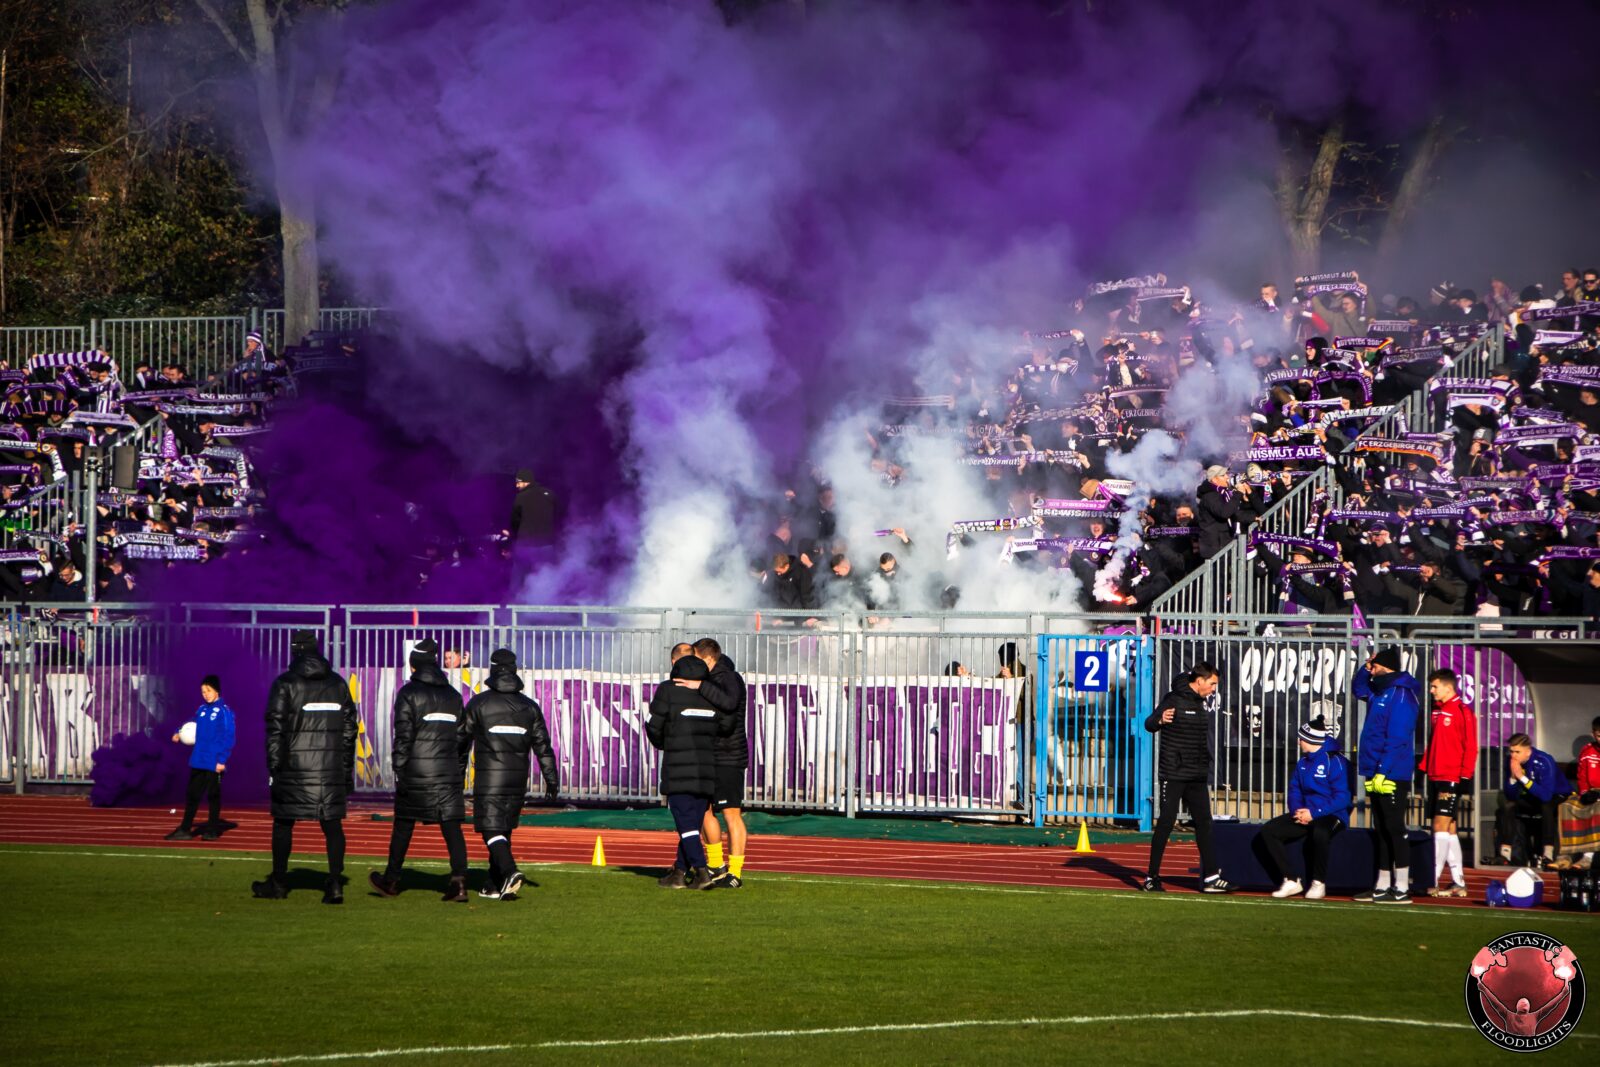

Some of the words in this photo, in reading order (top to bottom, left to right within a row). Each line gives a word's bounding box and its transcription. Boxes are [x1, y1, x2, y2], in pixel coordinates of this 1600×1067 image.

[1246, 447, 1294, 459] WISMUT
[1296, 447, 1322, 457] AUE
[1358, 440, 1368, 448] FC
[1369, 441, 1416, 451] ERZGEBIRGE
[1417, 444, 1434, 453] AUE
[1083, 655, 1100, 687] 2
